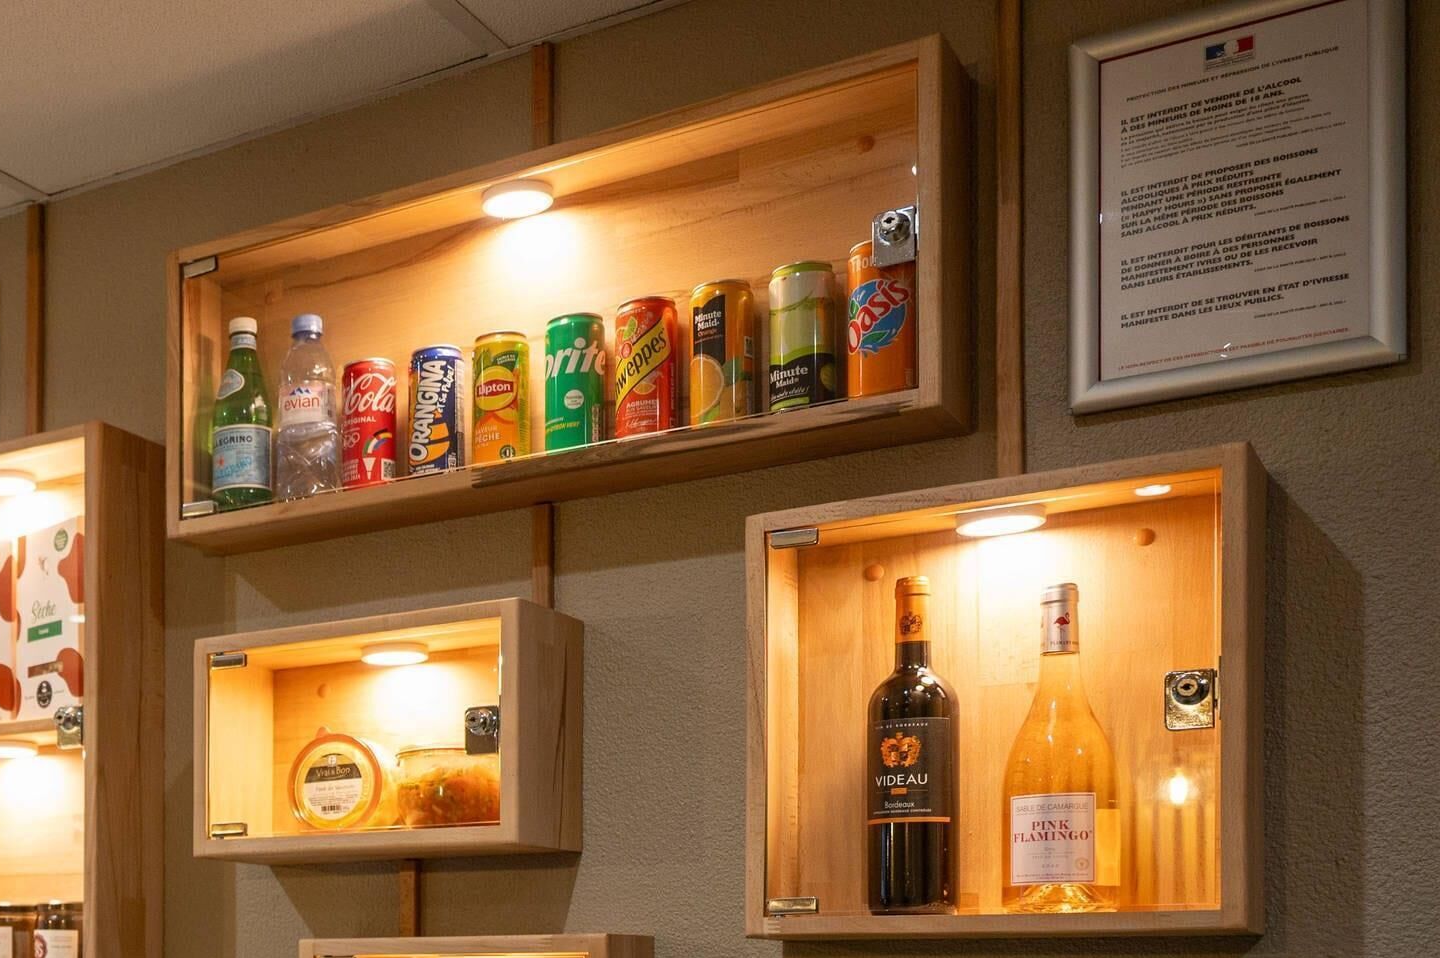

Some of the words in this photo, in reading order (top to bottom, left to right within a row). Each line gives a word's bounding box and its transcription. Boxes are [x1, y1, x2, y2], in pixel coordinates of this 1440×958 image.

[1129, 122, 1145, 131] DES
[1147, 112, 1187, 126] MINEURS
[1189, 108, 1201, 116] DE
[1203, 101, 1232, 113] MOINS
[1235, 97, 1247, 106] DE
[1262, 88, 1285, 99] ANS.
[1130, 114, 1145, 123] EST
[1147, 103, 1189, 118] INTERDIT
[1190, 100, 1202, 108] DE
[1204, 90, 1241, 105] VENDRE
[1243, 87, 1254, 96] DE
[1257, 76, 1301, 92] L'ALCOOL
[1120, 186, 1179, 204] ALCOOLIQUES
[1182, 182, 1188, 190] À
[1191, 178, 1213, 188] PRIX
[1215, 169, 1254, 183] RÉDUITS
[1130, 185, 1144, 194] EST
[1147, 175, 1189, 190] INTERDIT
[1191, 172, 1202, 180] DE
[1205, 161, 1251, 177] PROPOSER
[1253, 157, 1270, 166] DES
[1273, 147, 1318, 162] BOISSONS
[1120, 198, 1163, 212] PENDANT
[1165, 193, 1184, 203] UNE
[1186, 184, 1224, 198] PÉRIODE
[1226, 172, 1281, 189] RESTREINTE
[1132, 206, 1162, 218] HAPPY
[1164, 199, 1194, 211] HOURS
[1208, 190, 1232, 201] SANS
[1234, 180, 1282, 196] PROPOSER
[1284, 168, 1342, 186] ÉGALEMENT
[1153, 210, 1178, 222] MÊME
[1180, 202, 1218, 216] PÉRIODE
[1220, 198, 1237, 207] DES
[1239, 188, 1284, 203] BOISSONS
[1120, 227, 1143, 237] SANS
[1145, 219, 1180, 232] ALCOOL
[1182, 215, 1188, 224] À
[1191, 212, 1213, 222] PRIX
[1215, 202, 1256, 216] RÉDUITS.
[1120, 266, 1132, 274] DE
[1134, 258, 1172, 271] DONNER
[1174, 255, 1181, 263] À
[1183, 250, 1210, 261] BOIRE
[1212, 247, 1220, 255] À
[1222, 244, 1238, 253] DES
[1241, 233, 1295, 250] PERSONNES
[1130, 255, 1145, 263] EST
[1147, 246, 1188, 260] INTERDIT
[1191, 240, 1216, 251] POUR
[1218, 237, 1232, 246] LES
[1235, 226, 1286, 242] DÉBITANTS
[1288, 224, 1300, 232] DE
[1304, 214, 1349, 229] BOISSONS
[1120, 262, 1194, 282] MANIFESTEMENT
[1196, 256, 1221, 267] IVRES
[1224, 253, 1237, 261] OU
[1240, 250, 1252, 258] DE
[1254, 247, 1269, 255] LES
[1271, 237, 1318, 252] RECEVOIR
[1120, 280, 1145, 290] DANS
[1147, 274, 1173, 285] LEURS
[1175, 258, 1253, 279] ÉTABLISSEMENTS.
[1120, 314, 1169, 328] MANIFESTE
[1171, 309, 1196, 319] DANS
[1198, 305, 1212, 314] LES
[1215, 300, 1241, 311] LIEUX
[1244, 292, 1284, 306] PUBLICS.
[1130, 310, 1145, 318] EST
[1147, 302, 1189, 315] INTERDIT
[1191, 299, 1202, 307] DE
[1216, 288, 1260, 302] TROUVER
[1262, 286, 1275, 294] EN
[1277, 281, 1300, 291] ÉTAT
[1302, 272, 1349, 286] D'IVRESSE
[694, 310, 722, 324] Minute
[848, 279, 910, 355] Oasis
[478, 383, 511, 396] Lipton
[769, 365, 808, 384] Minute
[284, 396, 320, 411] evian
[409, 360, 449, 463] ORANGINA
[875, 773, 928, 787] VIDEAU
[884, 800, 915, 809] Bordeaux
[1047, 802, 1089, 810] CAMARGUE
[1014, 830, 1089, 843] FLAMINGO
[1032, 819, 1070, 831] PINK
